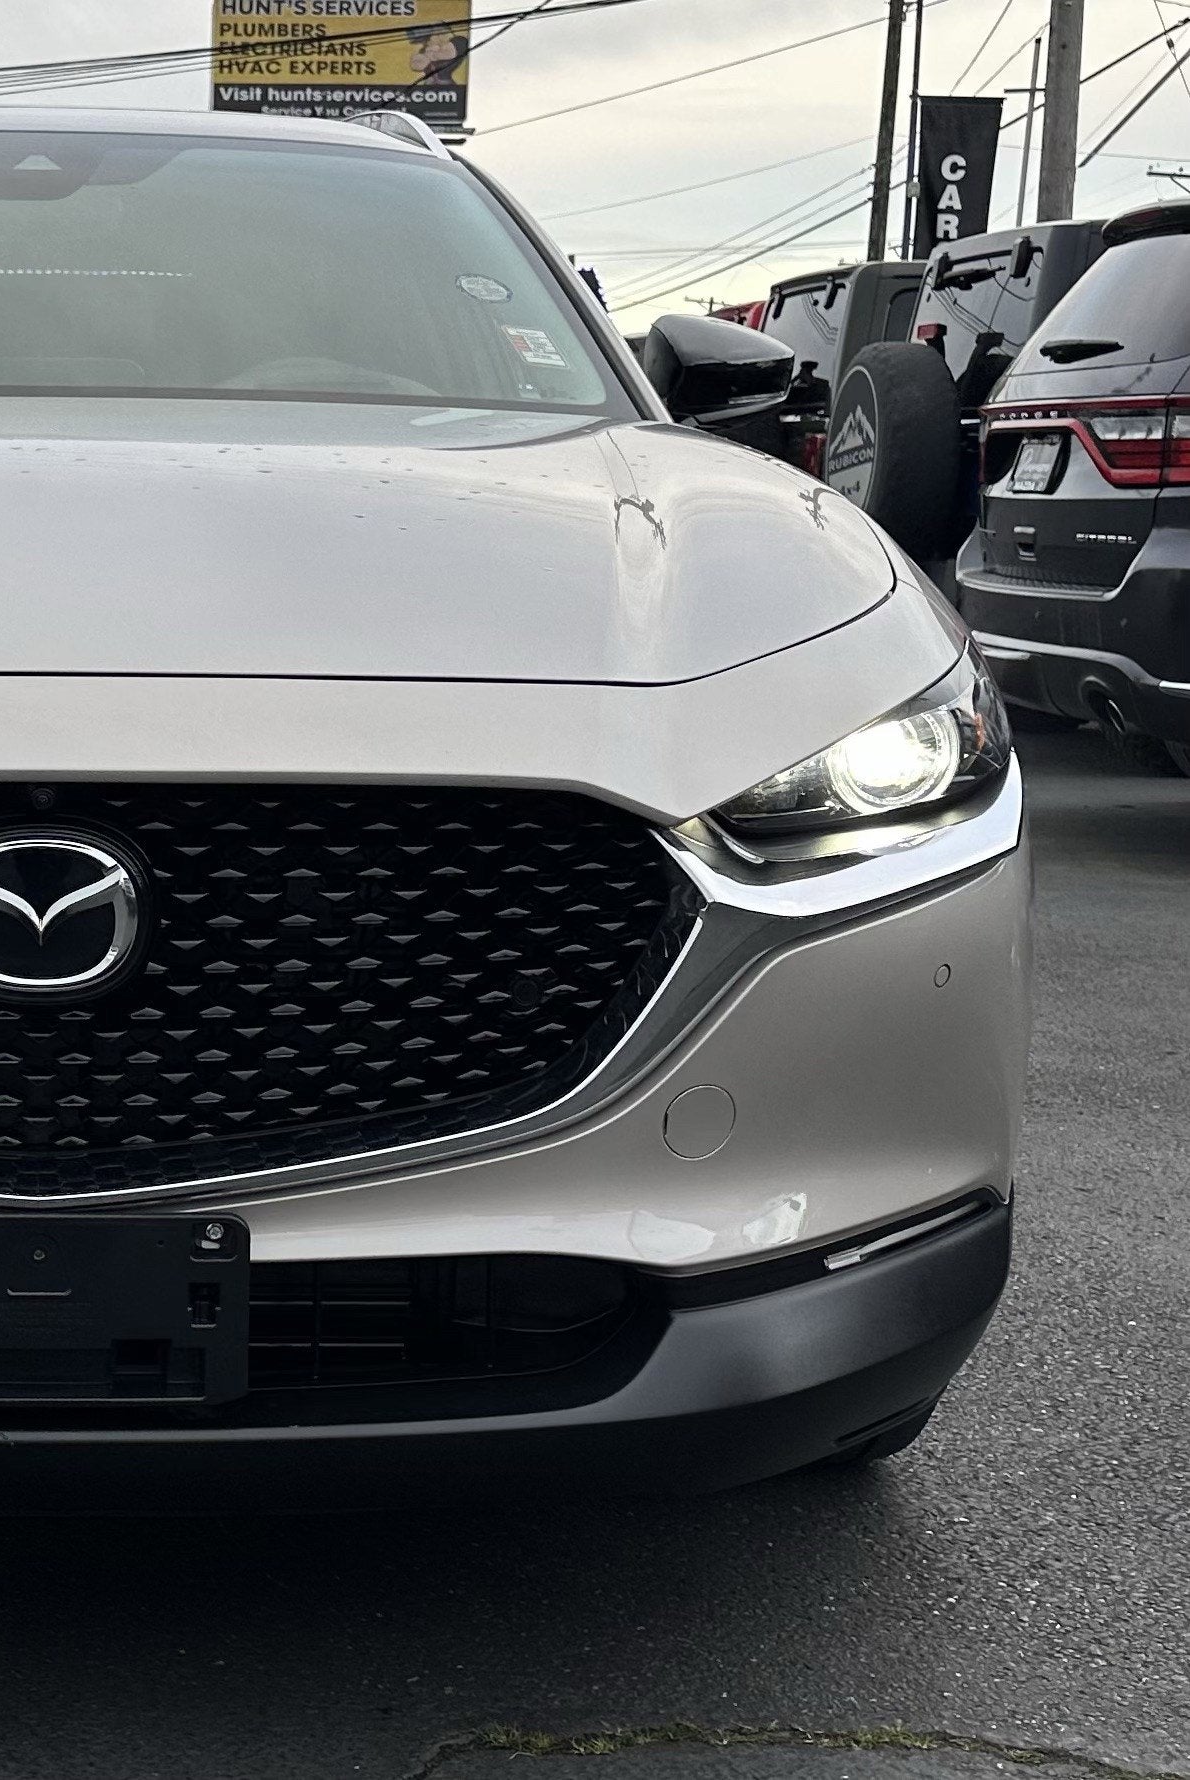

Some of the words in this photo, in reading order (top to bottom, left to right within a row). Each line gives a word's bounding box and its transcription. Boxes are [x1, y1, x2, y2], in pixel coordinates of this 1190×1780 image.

[222, 0, 307, 15] HUNT'S
[311, 0, 415, 16] SERVICES
[219, 23, 326, 37] PLUMBERS
[219, 60, 281, 75] HVAC
[290, 61, 376, 75] EXPERTS
[219, 86, 262, 101] Visit
[829, 447, 874, 472] RUBICON
